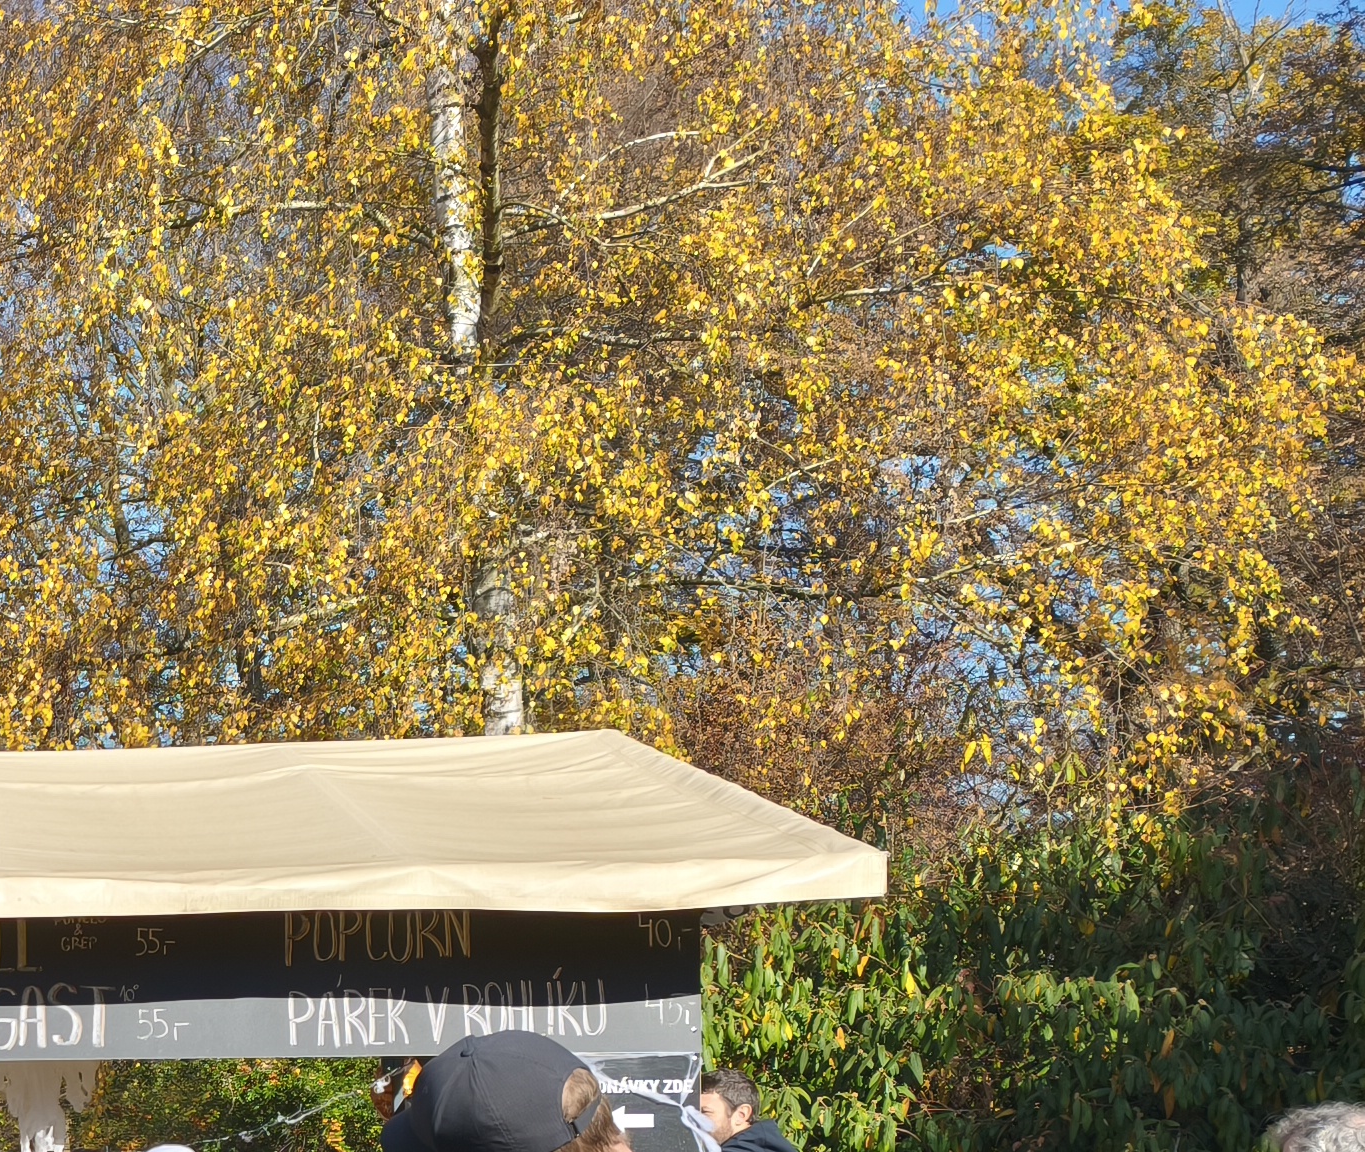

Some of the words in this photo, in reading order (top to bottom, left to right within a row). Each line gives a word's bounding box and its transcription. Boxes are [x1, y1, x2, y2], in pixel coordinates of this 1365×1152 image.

[61, 936, 98, 951] GREP
[284, 911, 471, 967] POPCORN
[288, 974, 410, 1048] PÁREK
[425, 985, 450, 1045] V
[663, 1079, 693, 1093] ZDE
